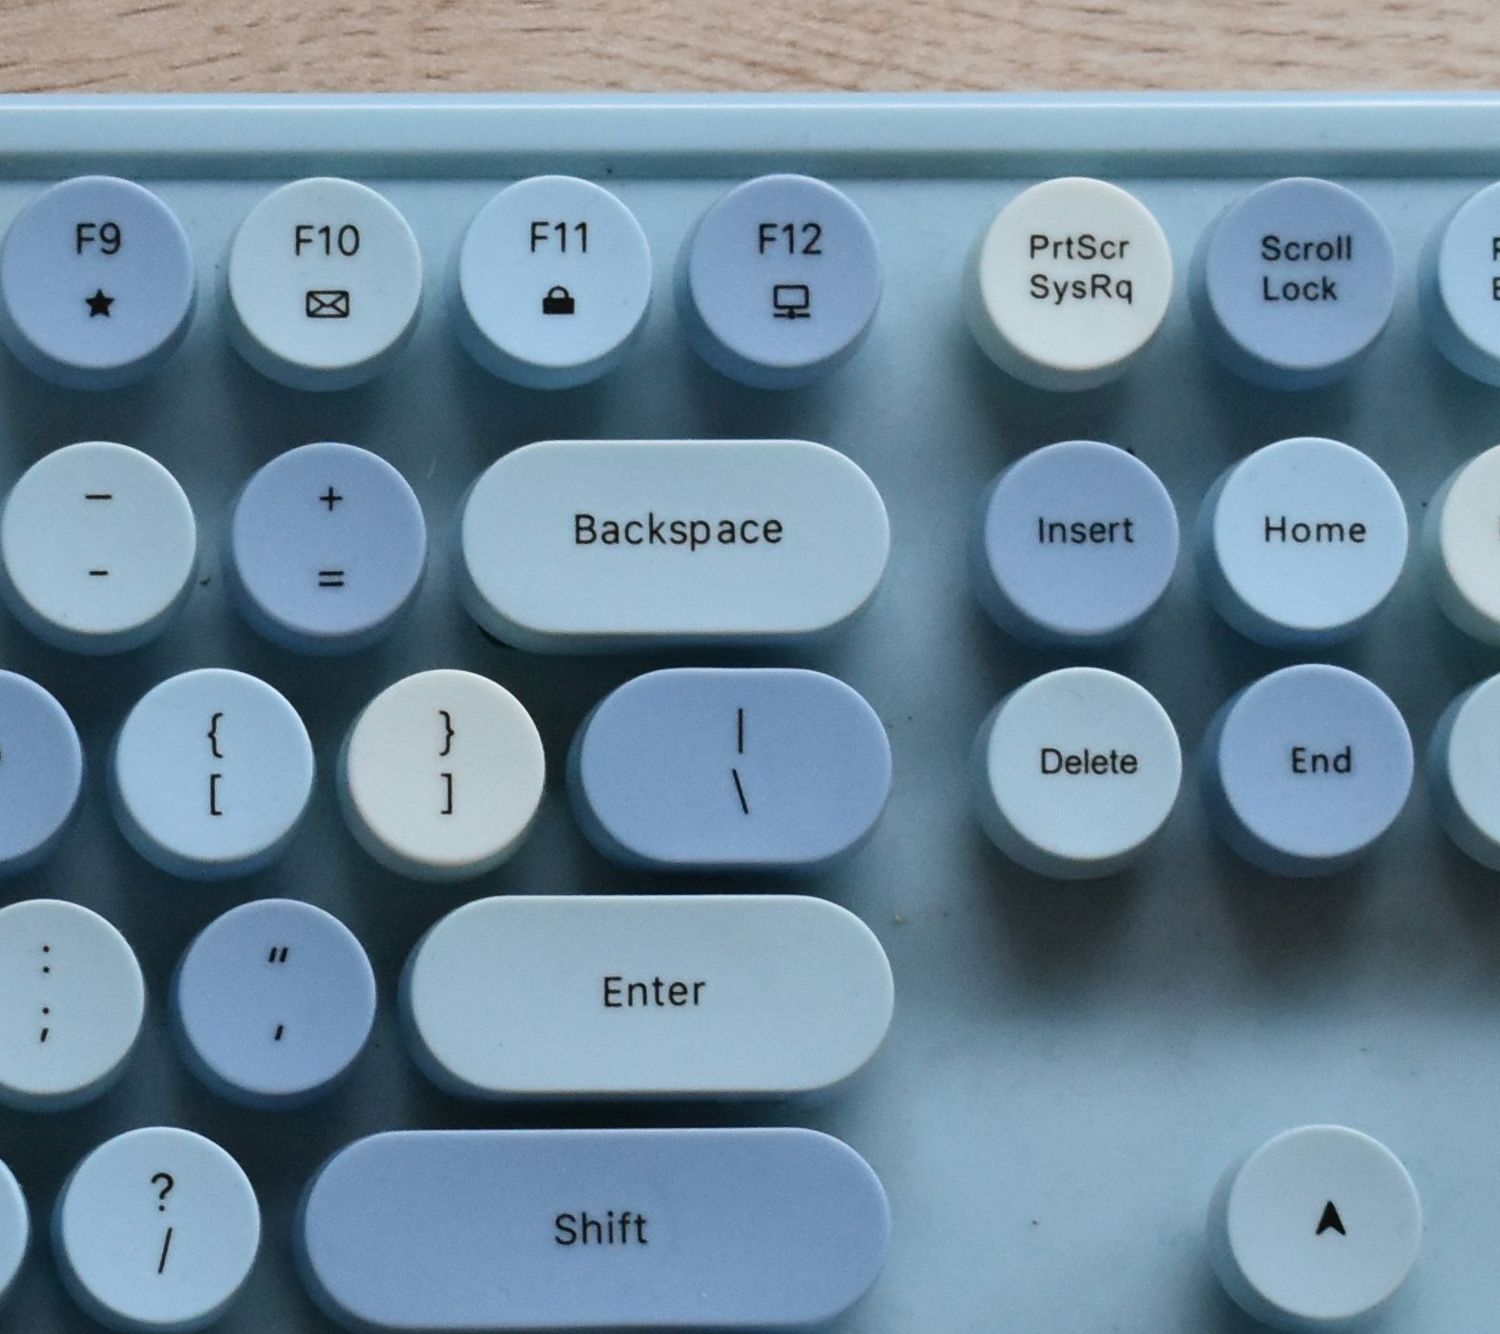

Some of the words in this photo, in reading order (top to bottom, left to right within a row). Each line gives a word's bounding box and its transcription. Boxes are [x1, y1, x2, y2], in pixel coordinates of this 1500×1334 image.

[76, 222, 121, 255] F9
[295, 224, 360, 257] F10
[530, 221, 587, 253] F11
[758, 222, 822, 255] F12
[1030, 234, 1129, 260] PrtScr
[1261, 235, 1352, 262] Scroll
[1030, 273, 1132, 305] SysRq
[1263, 276, 1337, 302] Lock
[319, 487, 343, 511] +
[575, 512, 783, 551] Backspace
[1038, 517, 1133, 544] Insert
[1265, 516, 1366, 543] Home
[318, 570, 344, 588] =
[207, 712, 223, 759] {
[439, 710, 455, 757] }
[1041, 748, 1138, 775] Delete
[1291, 746, 1352, 774] End
[209, 772, 223, 817] [
[440, 772, 454, 816] ]
[732, 769, 749, 814] \
[604, 976, 705, 1008] Enter
[151, 1172, 174, 1212] ?
[555, 1211, 647, 1246] Shift
[158, 1227, 173, 1274] /
